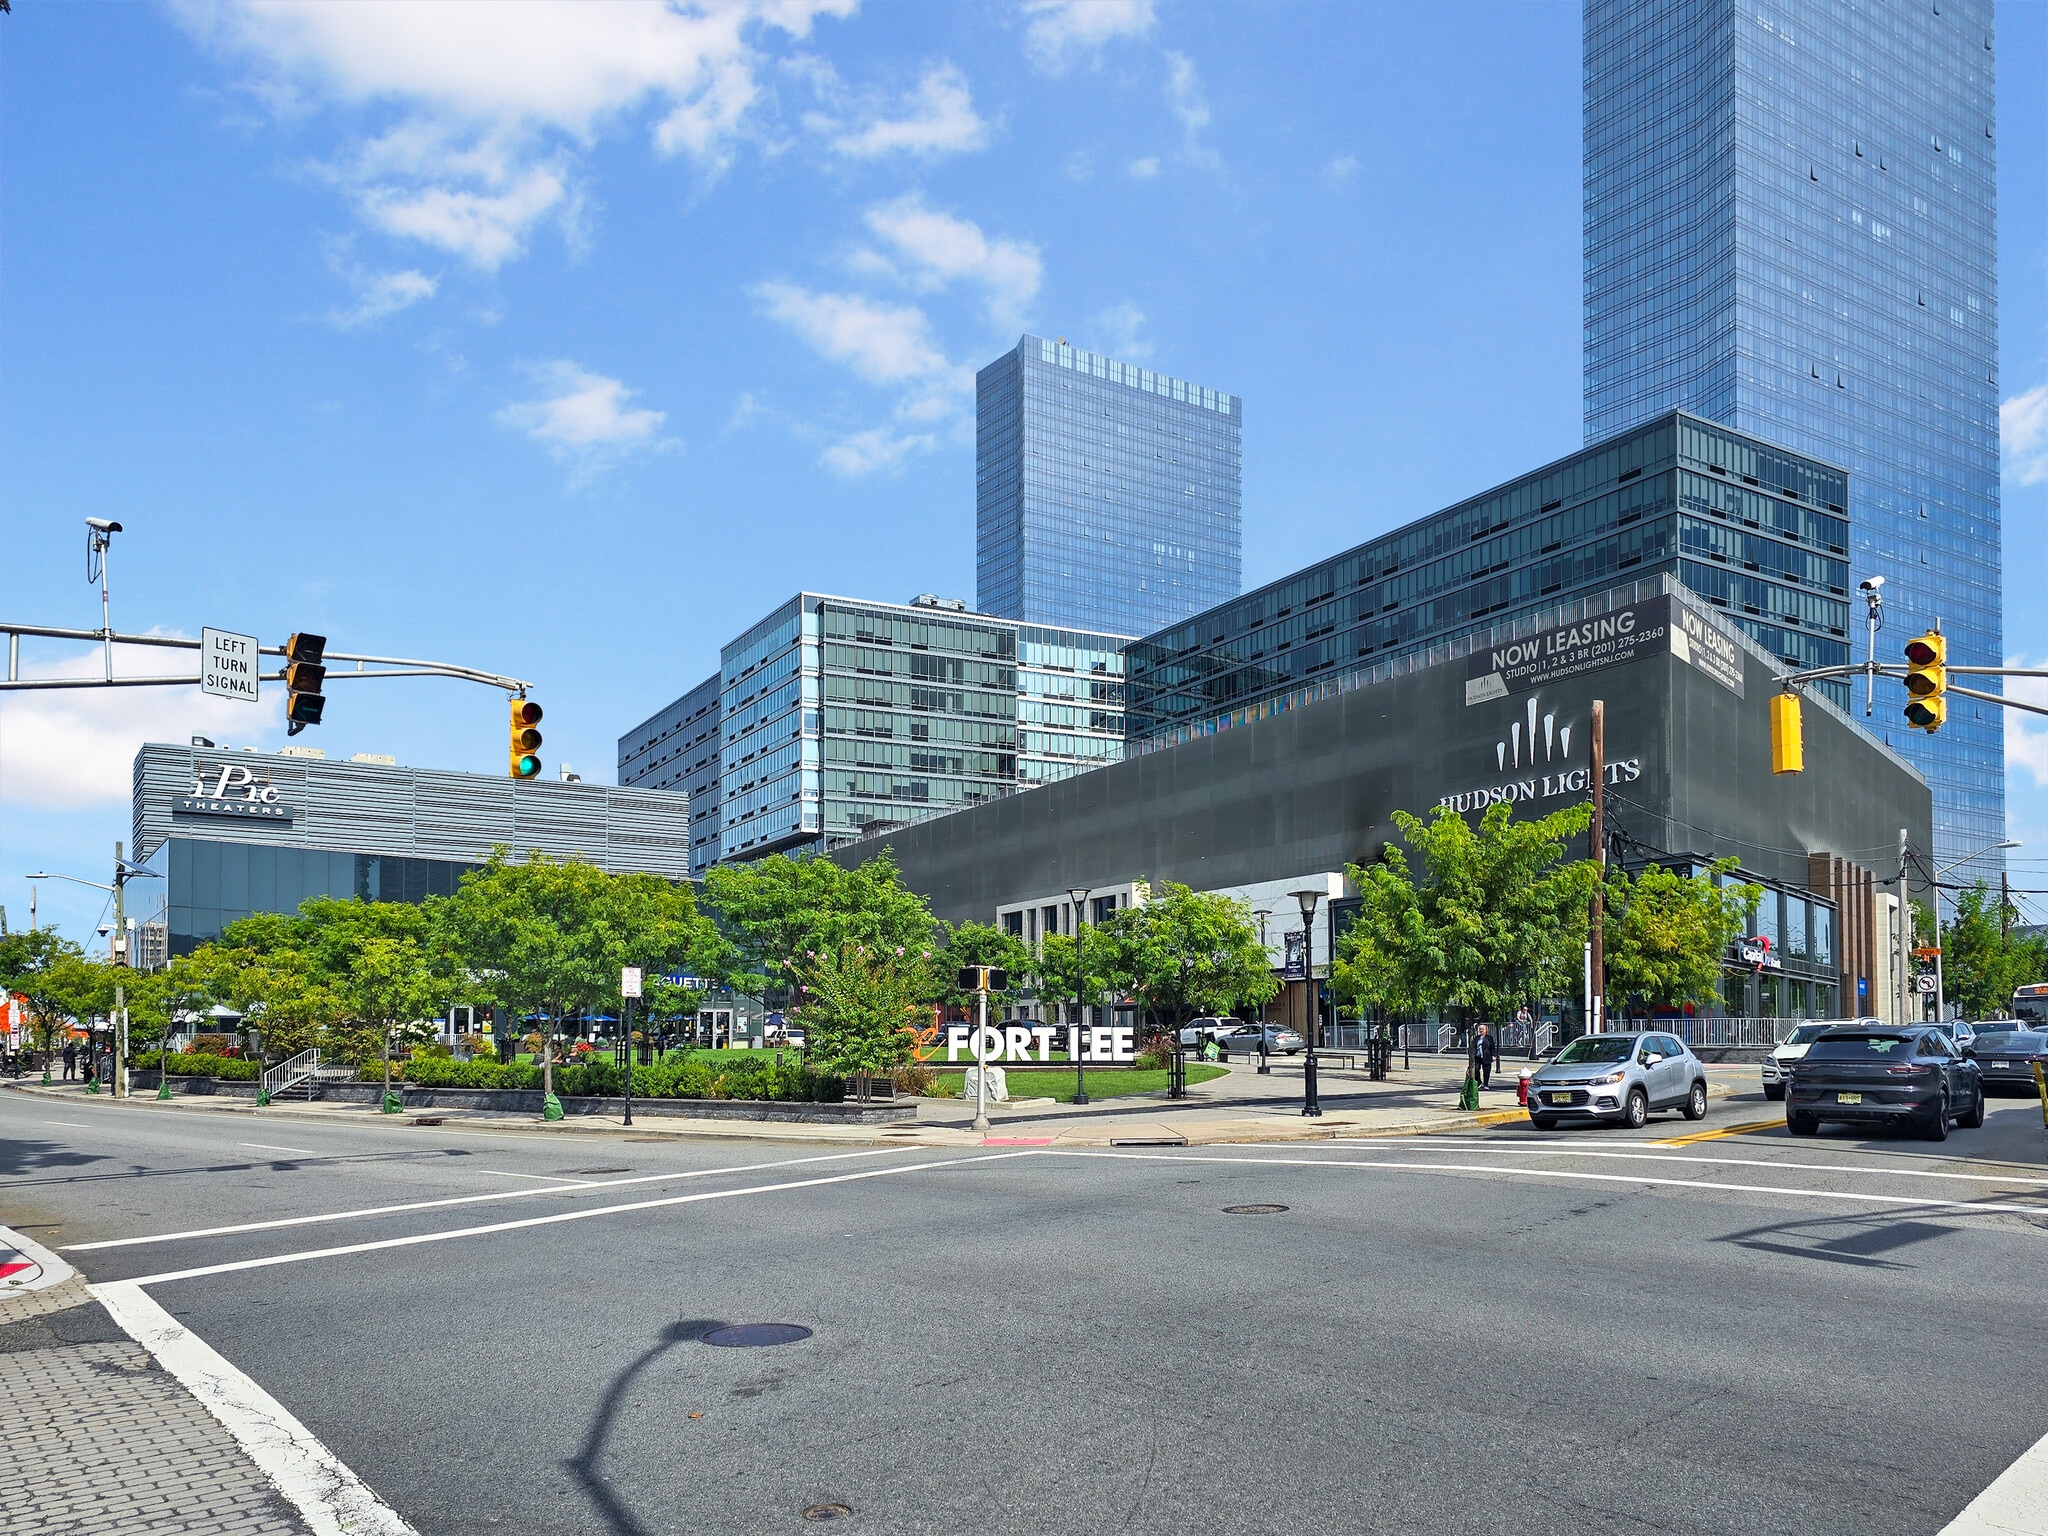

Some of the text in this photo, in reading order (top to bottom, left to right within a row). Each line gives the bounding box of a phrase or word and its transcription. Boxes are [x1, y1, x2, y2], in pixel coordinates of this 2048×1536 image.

[215, 637, 246, 654] LEFT
[1492, 612, 1636, 670] NOW LEASING
[1506, 663, 1536, 679] STUDIO
[1552, 657, 1558, 667] 2
[1560, 655, 1567, 664] &
[1569, 652, 1575, 661] 3
[1577, 648, 1589, 660] BR
[1591, 640, 1615, 657] (201)
[1617, 626, 1664, 648] 275-2360
[1682, 609, 1735, 664] NOW LEASING
[213, 656, 247, 674] TURN
[1530, 649, 1635, 684] WWW.HUDSONLIGHTSNJ.COM
[207, 674, 254, 694] SIGNAL
[1486, 688, 1503, 697] LIGHTS
[187, 763, 280, 804] iPic
[1440, 779, 1537, 813] HUDSON
[183, 800, 284, 815] THEATERS
[947, 1026, 1056, 1061] FORT
[1069, 1026, 1134, 1061] LEE
